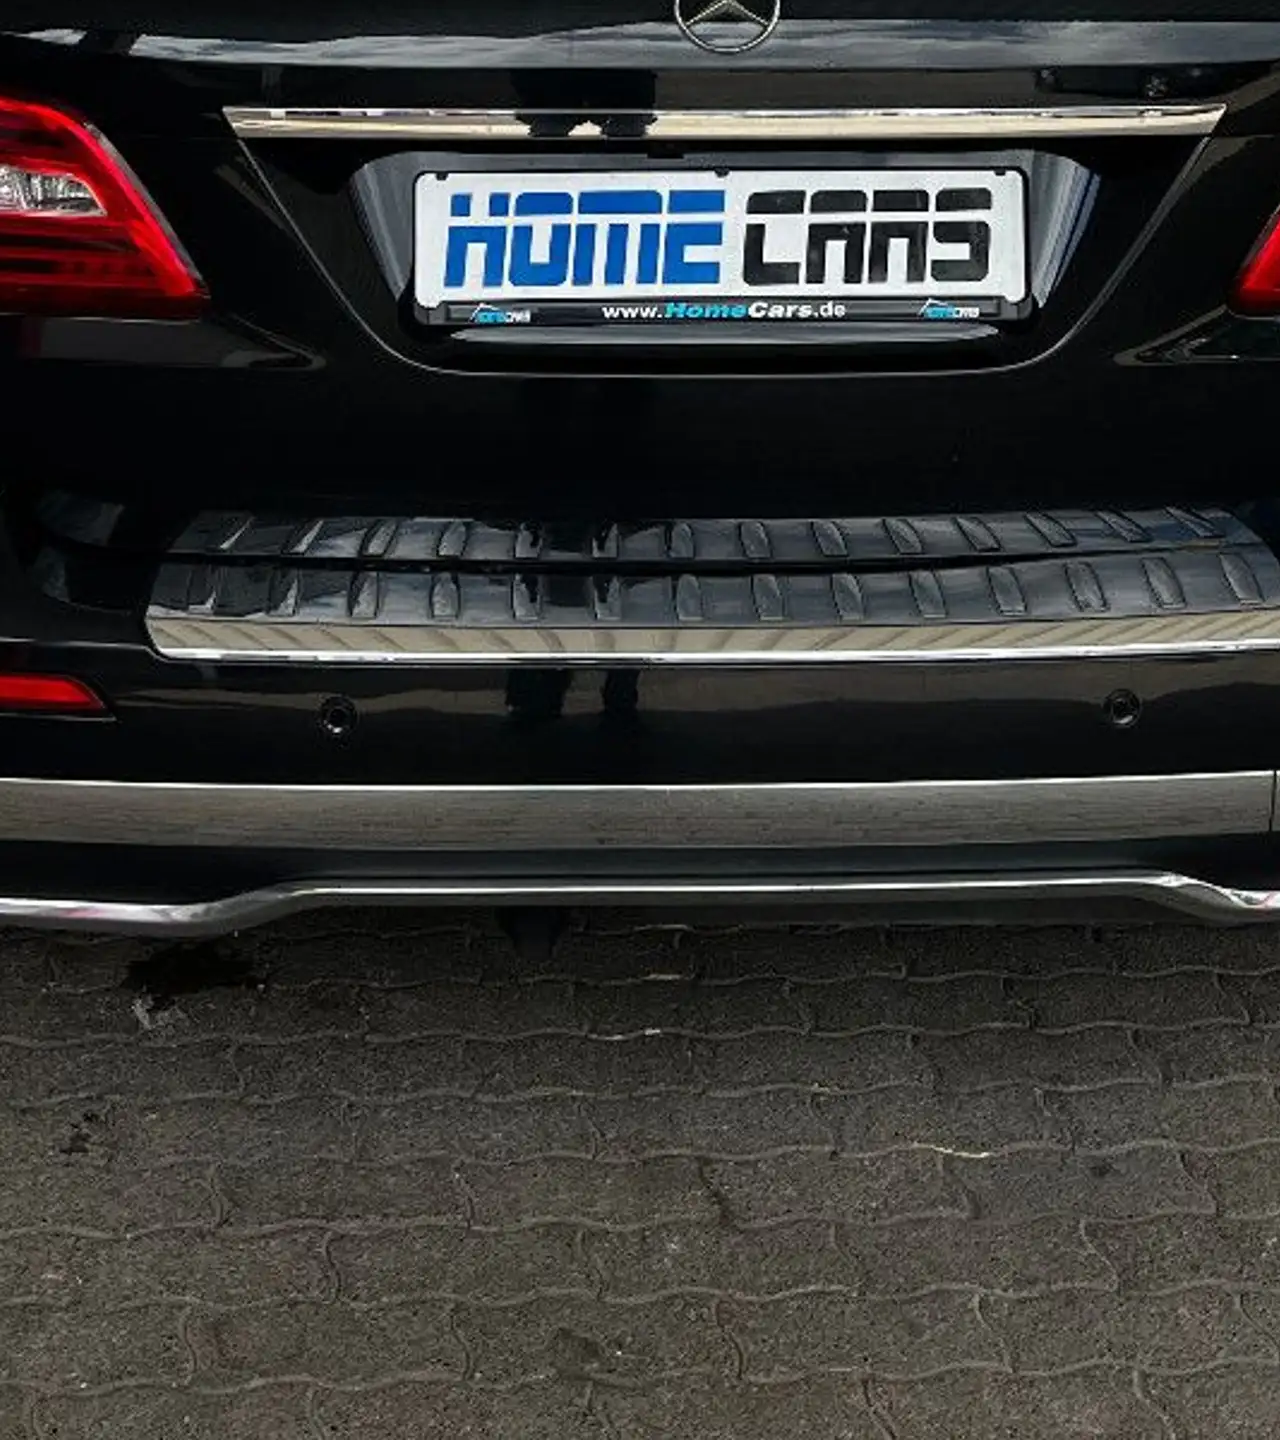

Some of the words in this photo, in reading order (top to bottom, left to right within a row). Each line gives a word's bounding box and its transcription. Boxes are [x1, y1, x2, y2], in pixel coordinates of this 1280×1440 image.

[443, 190, 726, 287] HOME
[743, 187, 992, 286] CARS
[602, 301, 846, 319] www.HomeCars.de
